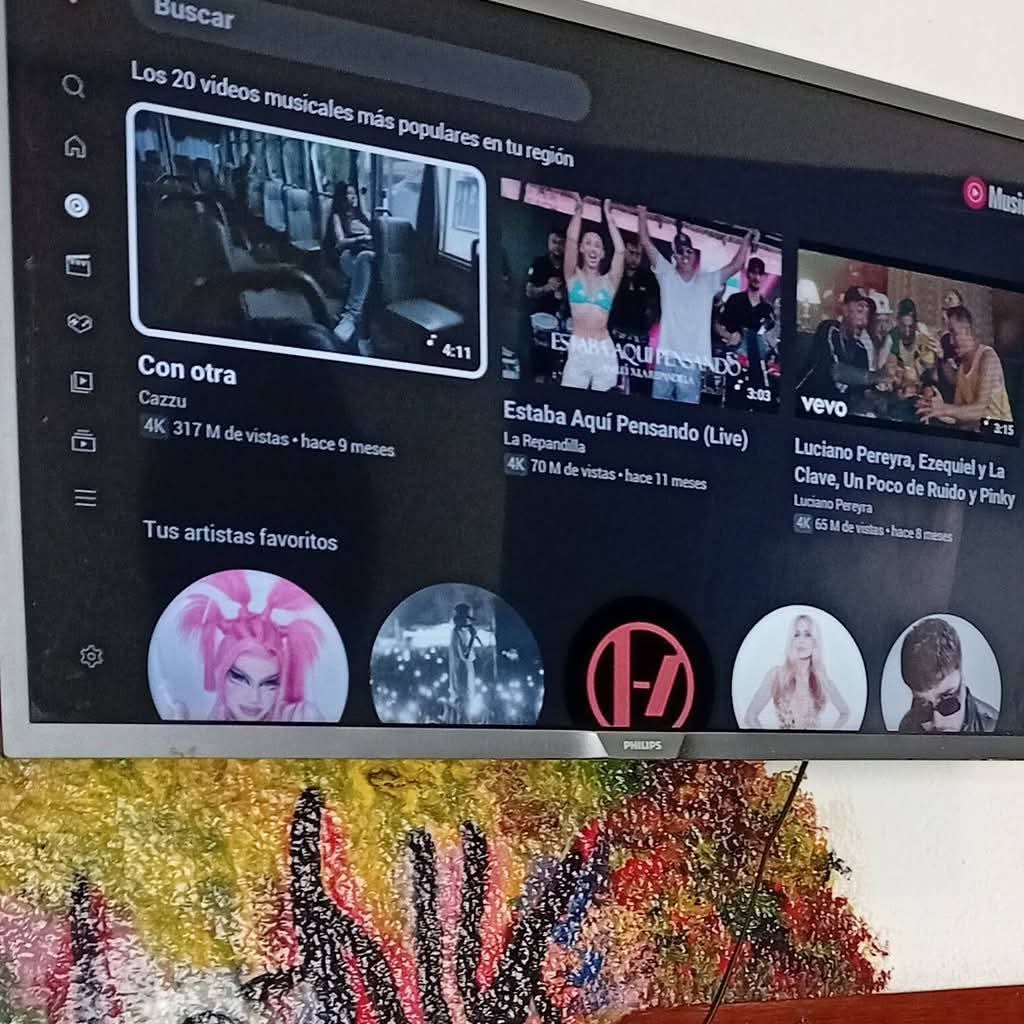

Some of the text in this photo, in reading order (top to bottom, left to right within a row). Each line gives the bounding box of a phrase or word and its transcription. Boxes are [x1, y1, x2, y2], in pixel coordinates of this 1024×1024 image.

[154, 0, 235, 29] Buscar
[131, 60, 168, 84] Los
[171, 69, 196, 90] 20
[264, 91, 355, 122] musicales
[357, 109, 395, 130] más
[398, 118, 480, 147] populares
[483, 136, 502, 153] en
[506, 139, 523, 158] tu
[526, 144, 575, 168] región
[442, 343, 472, 360] 4:11
[137, 353, 237, 385] Con otra
[138, 389, 187, 409] Cazzu
[746, 387, 772, 402] 3:03
[801, 396, 848, 418] vevo
[143, 418, 396, 457] 4K 317 M de vistas hace 9 meses
[503, 400, 749, 451] Estaba Aquí Pensando (Live)
[993, 422, 1015, 436] 3:15
[503, 431, 587, 453] La Repandilla
[795, 437, 1006, 480] Luciano Pereyra, Ezequiel y La
[507, 457, 708, 490] 4K 70 M de vistas hace 11 meses
[794, 466, 1016, 509] Clave, Un Poco de Ruido y Pinky
[794, 493, 874, 514] Luciano Pereyra
[143, 520, 339, 551] Tus artistas favoritos
[815, 518, 828, 532] 65
[841, 521, 855, 535] de
[856, 523, 885, 538] vistas
[890, 525, 914, 541] hace
[923, 530, 953, 543] meses
[623, 740, 662, 751] PHILIPS
